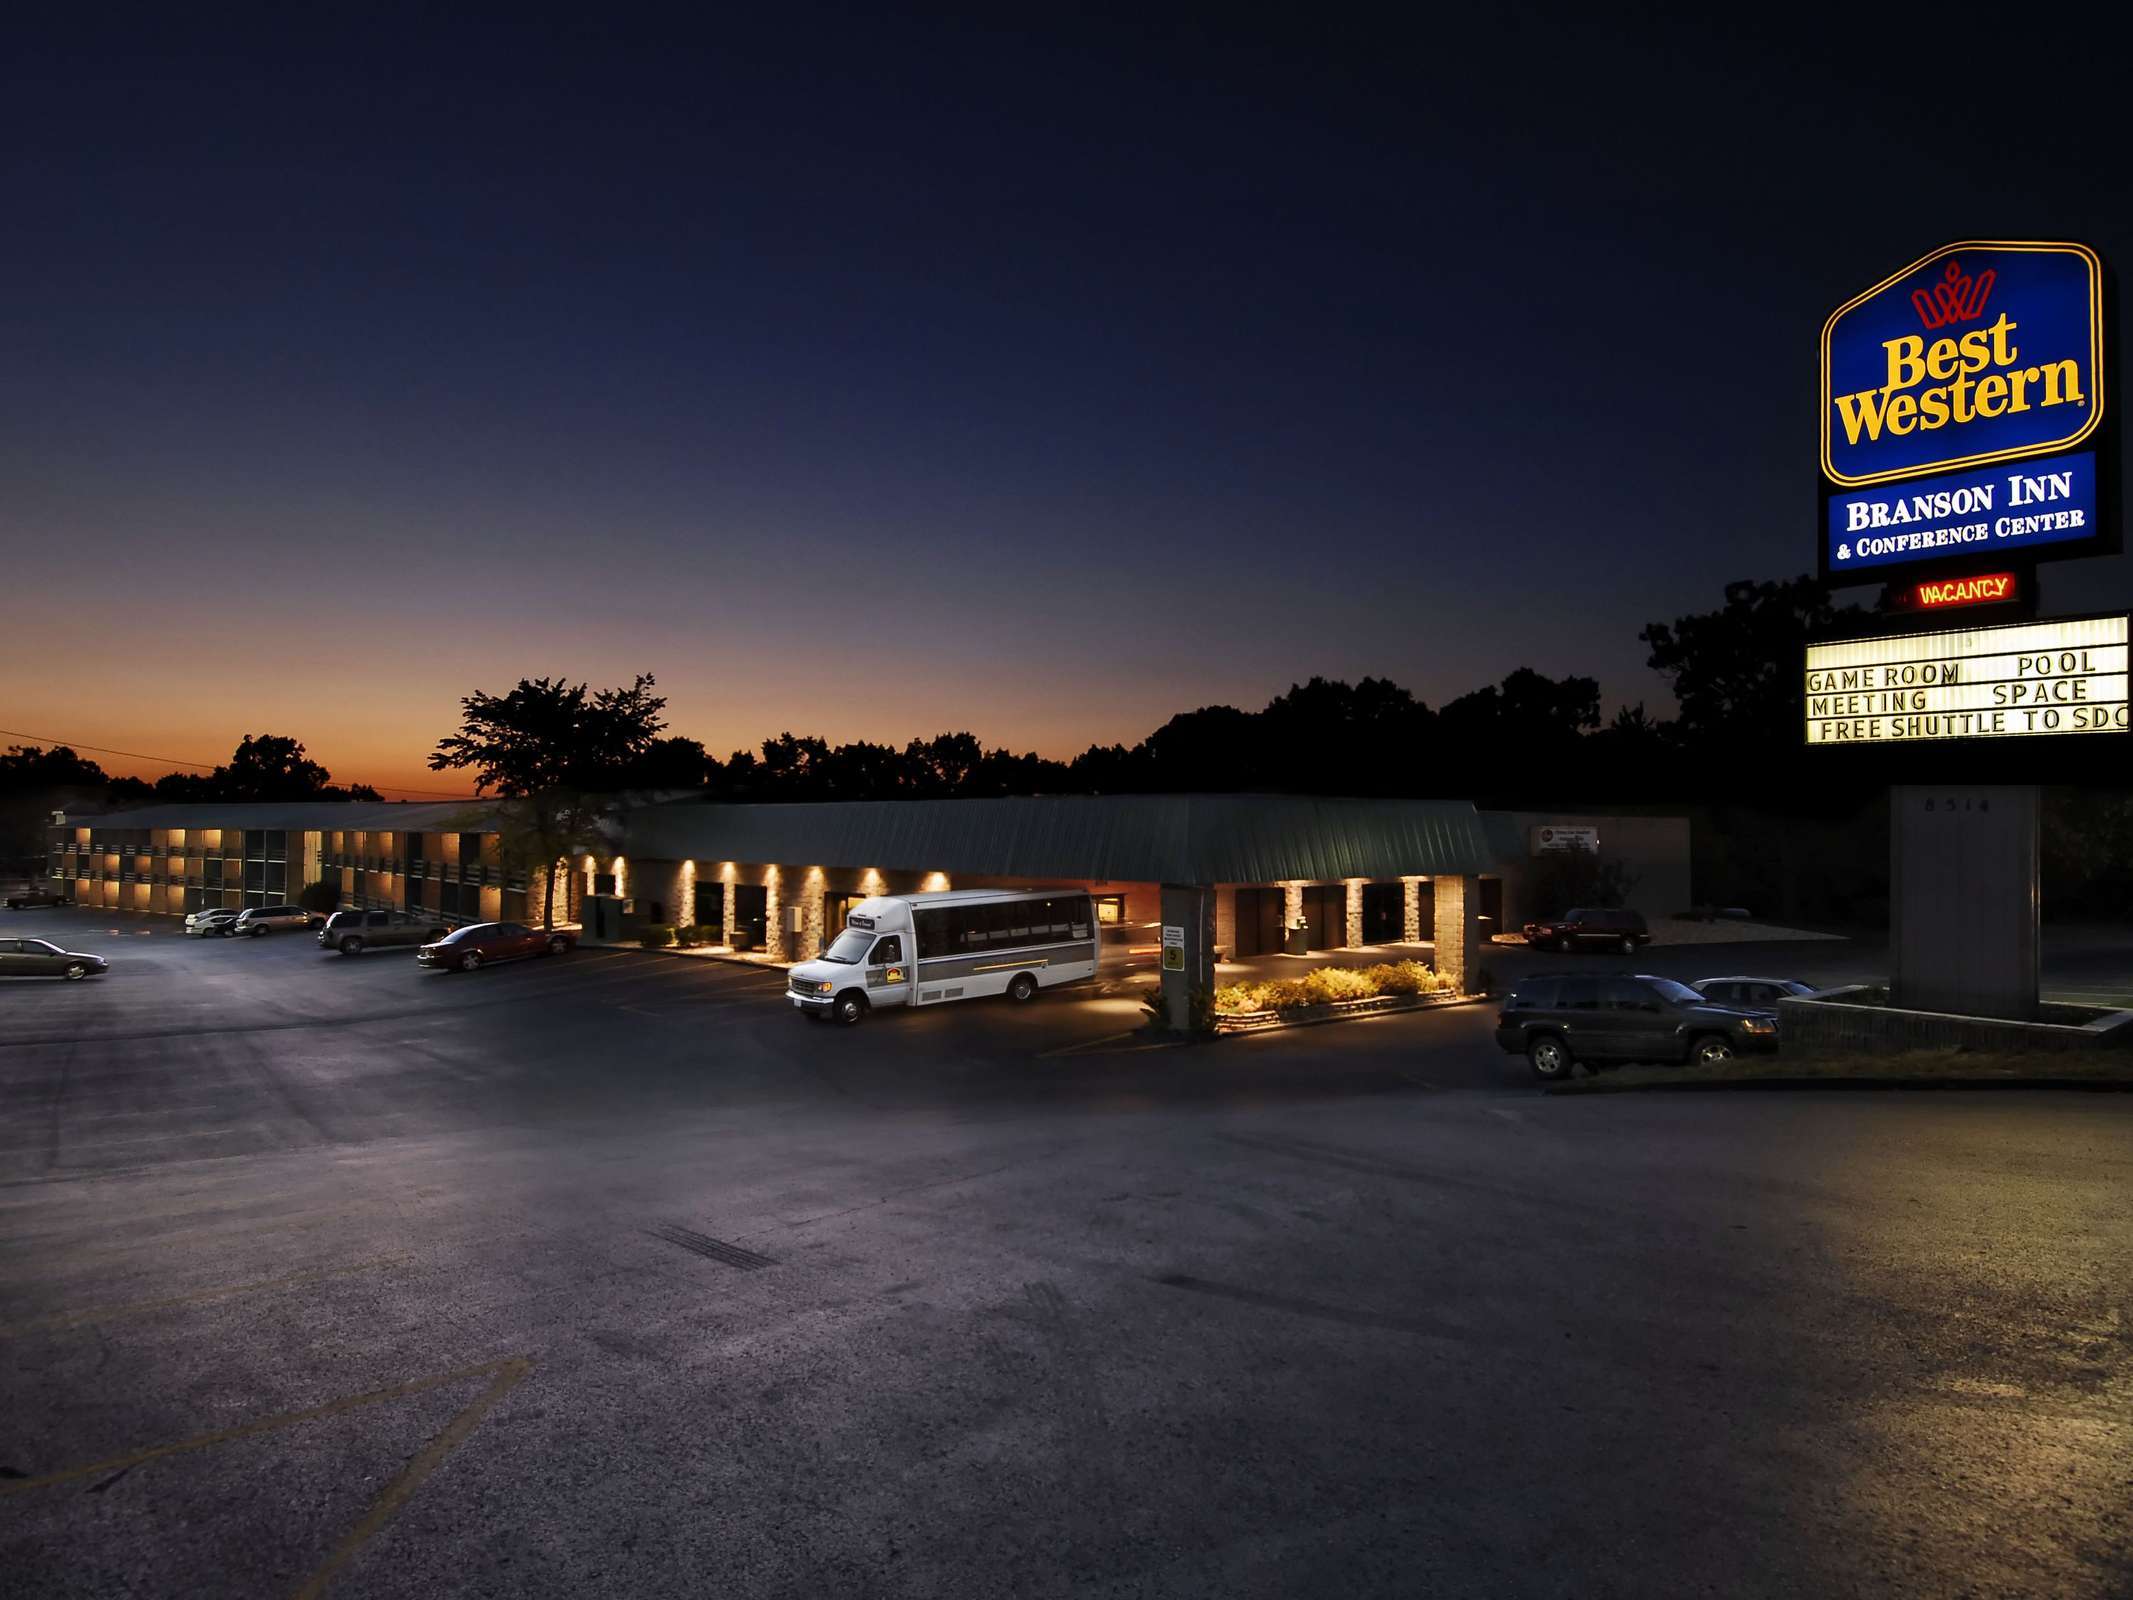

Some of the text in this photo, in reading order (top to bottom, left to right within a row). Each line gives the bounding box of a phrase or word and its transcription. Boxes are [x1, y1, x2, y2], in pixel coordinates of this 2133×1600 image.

[1882, 313, 2018, 392] Best
[1835, 359, 2085, 445] Western
[1846, 472, 2073, 532] BRANSON INN
[1836, 510, 2085, 560] & CONFERENCE CENTER
[1920, 577, 2008, 604] VACANCY
[1808, 652, 2096, 692] GAME ROOM POOL
[1812, 680, 2087, 716] MEETING SPACE
[1820, 720, 1881, 740] FREE
[1891, 712, 2006, 738] SHUTTLE
[2023, 709, 2060, 731] TO
